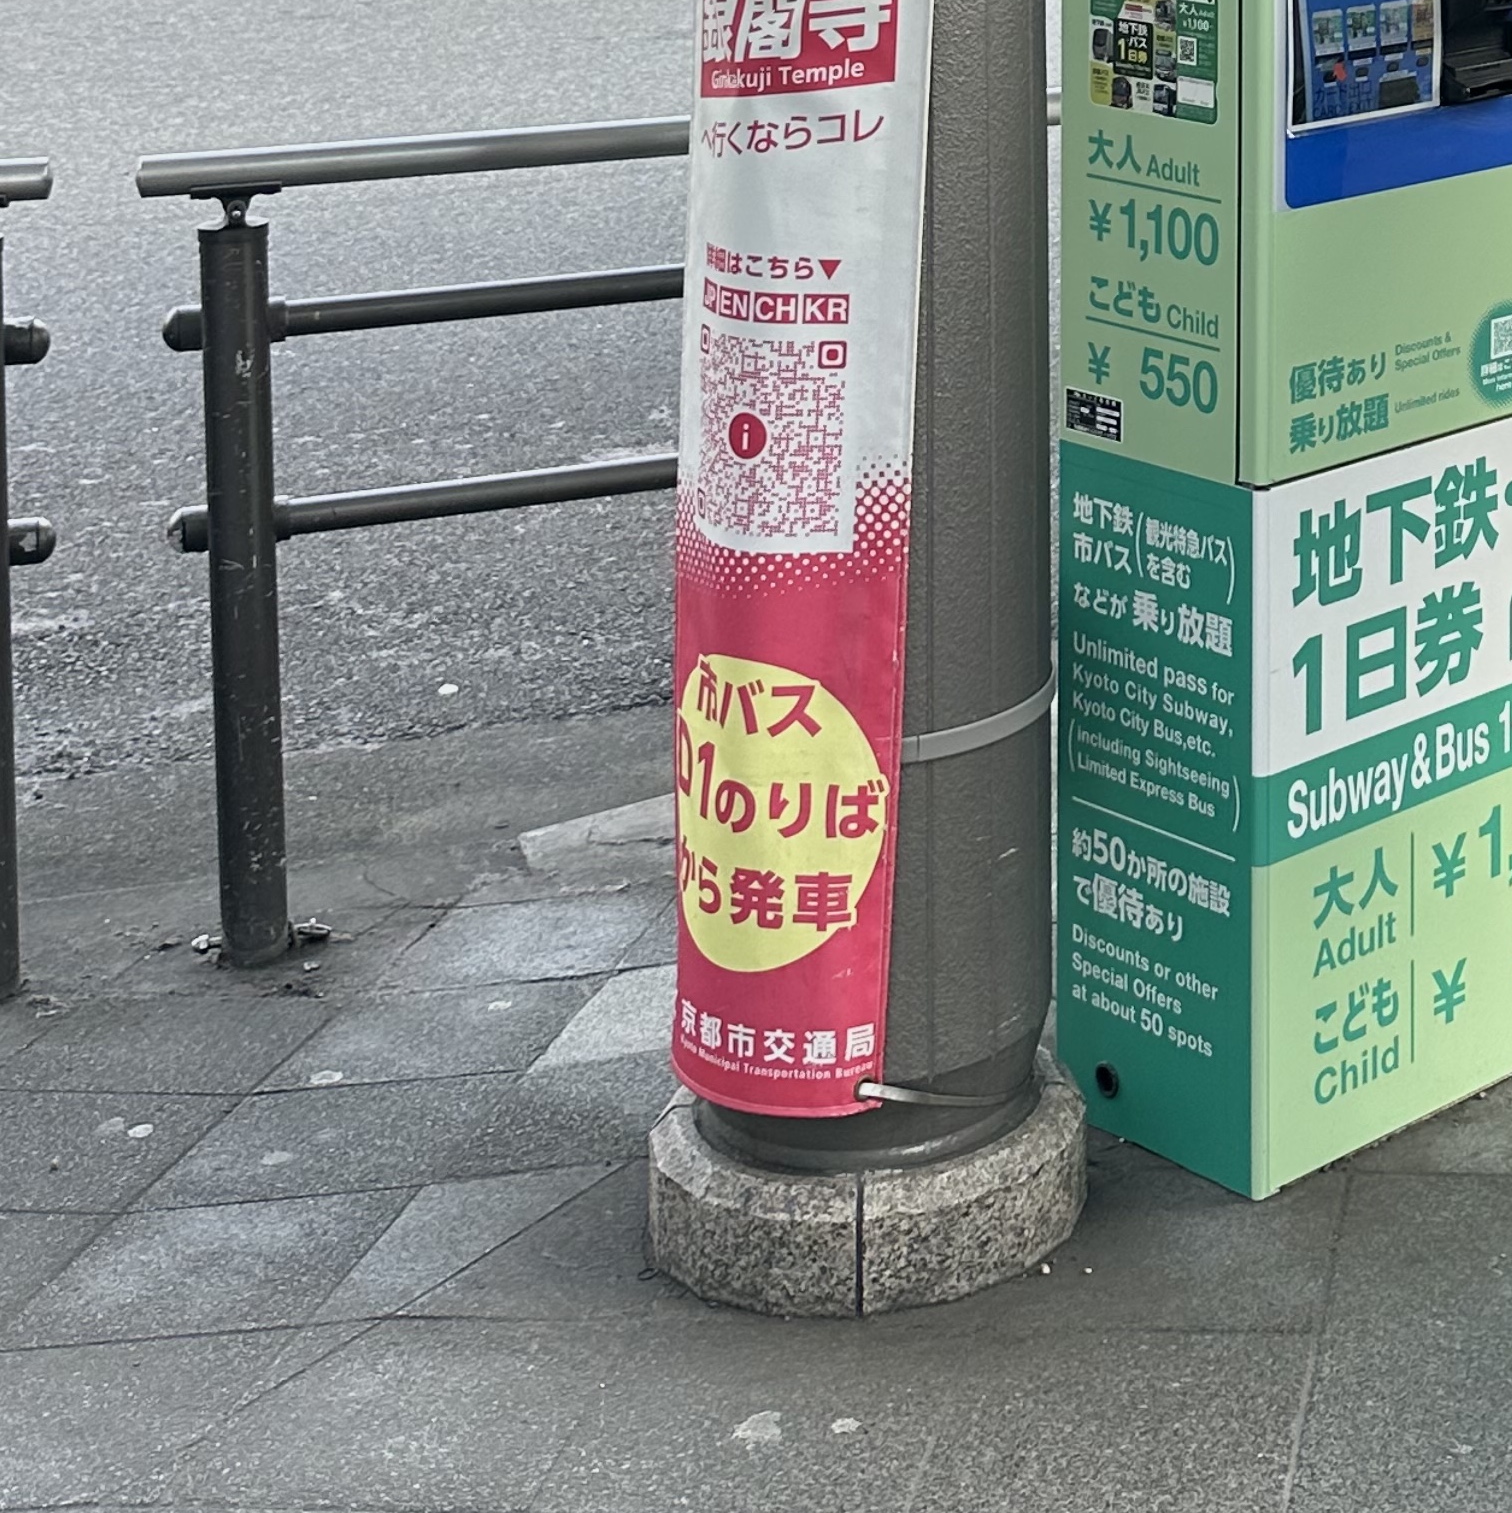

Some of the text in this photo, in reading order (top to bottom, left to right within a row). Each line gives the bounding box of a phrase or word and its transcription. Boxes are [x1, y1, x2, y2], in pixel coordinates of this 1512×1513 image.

[778, 58, 865, 86] Temple
[702, 109, 885, 159] へ行くならコレ
[1088, 129, 1200, 188] 大人 Adult
[706, 242, 814, 280] 詳細はこちら
[720, 290, 748, 318] EN
[755, 296, 796, 322] CH
[805, 298, 848, 322] KR
[1088, 275, 1220, 341] こども Child
[1289, 352, 1387, 405] 優待あり
[1395, 335, 1443, 356] Discounts
[1395, 346, 1461, 372] Special Offers
[1138, 346, 1218, 416] 550
[1394, 387, 1461, 414] Unlimited rides
[1289, 393, 1389, 455] 乗り放題
[1073, 490, 1229, 567] 地下鉄 観光特急バス
[1073, 532, 1192, 590] 市バス を含む
[1073, 581, 1234, 658] などが 乗り放題
[1073, 630, 1235, 706] Unlimited pass for
[1292, 581, 1484, 737] 1日券
[697, 658, 822, 737] 市バス
[1072, 662, 1234, 738] Kyoto City Subway,
[1072, 690, 1217, 758] Kyoto City Bus,etc.
[1077, 751, 1216, 818] Limited Express Bus
[1145, 749, 1231, 799] Sightseeing
[1287, 719, 1491, 840] Subway&Bus
[1072, 826, 1231, 918] 約50か所の施設
[1313, 846, 1399, 930] 大人
[1073, 873, 1184, 943] で優待あり
[1072, 923, 1219, 1002] Discounts or other
[1313, 911, 1397, 979] Adult
[1072, 952, 1182, 1015] Special Offers
[1314, 976, 1400, 1055] こども
[681, 999, 875, 1066] 京都市交通局
[1072, 982, 1213, 1058] at about 50 spots
[698, 1047, 740, 1072] Municipal
[743, 1063, 831, 1080] Transportation
[835, 1059, 874, 1079] Bureau
[1314, 1035, 1400, 1106] Child
